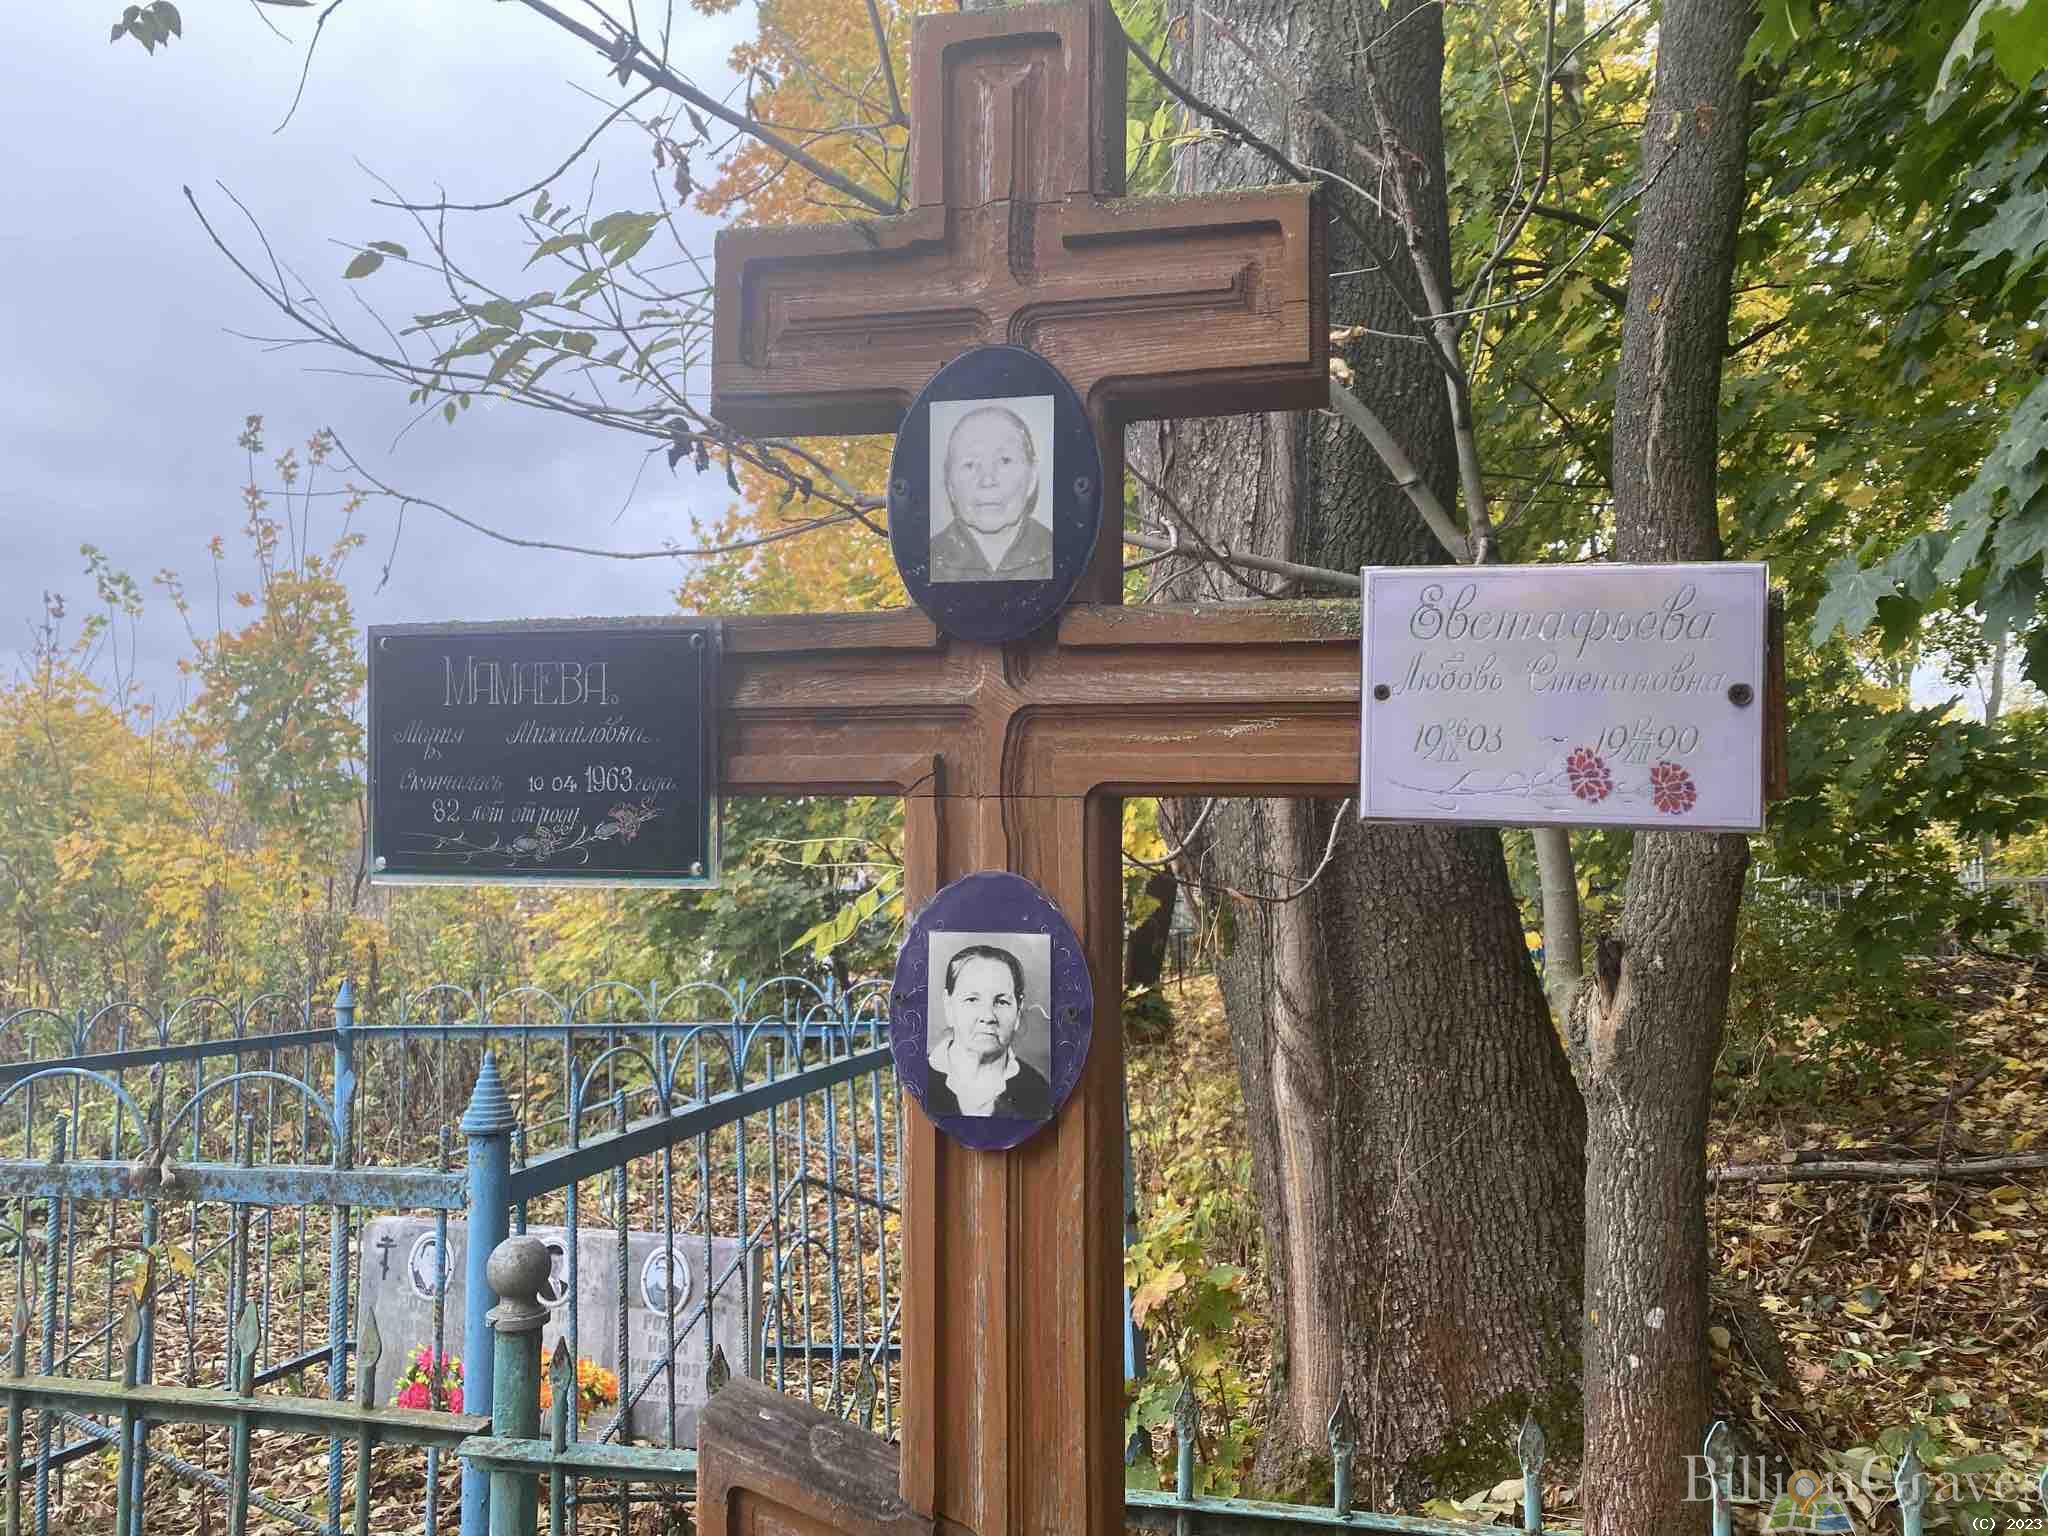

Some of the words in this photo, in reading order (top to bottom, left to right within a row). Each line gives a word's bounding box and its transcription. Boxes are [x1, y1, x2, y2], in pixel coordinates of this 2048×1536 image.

[1409, 583, 1717, 660] Евстафьева
[1392, 650, 1503, 696] Любовь
[1526, 649, 1728, 695] Степановна
[392, 719, 465, 761] Мария
[399, 767, 505, 793] Скончалась
[584, 765, 634, 793] 1963
[432, 798, 462, 823] 82
